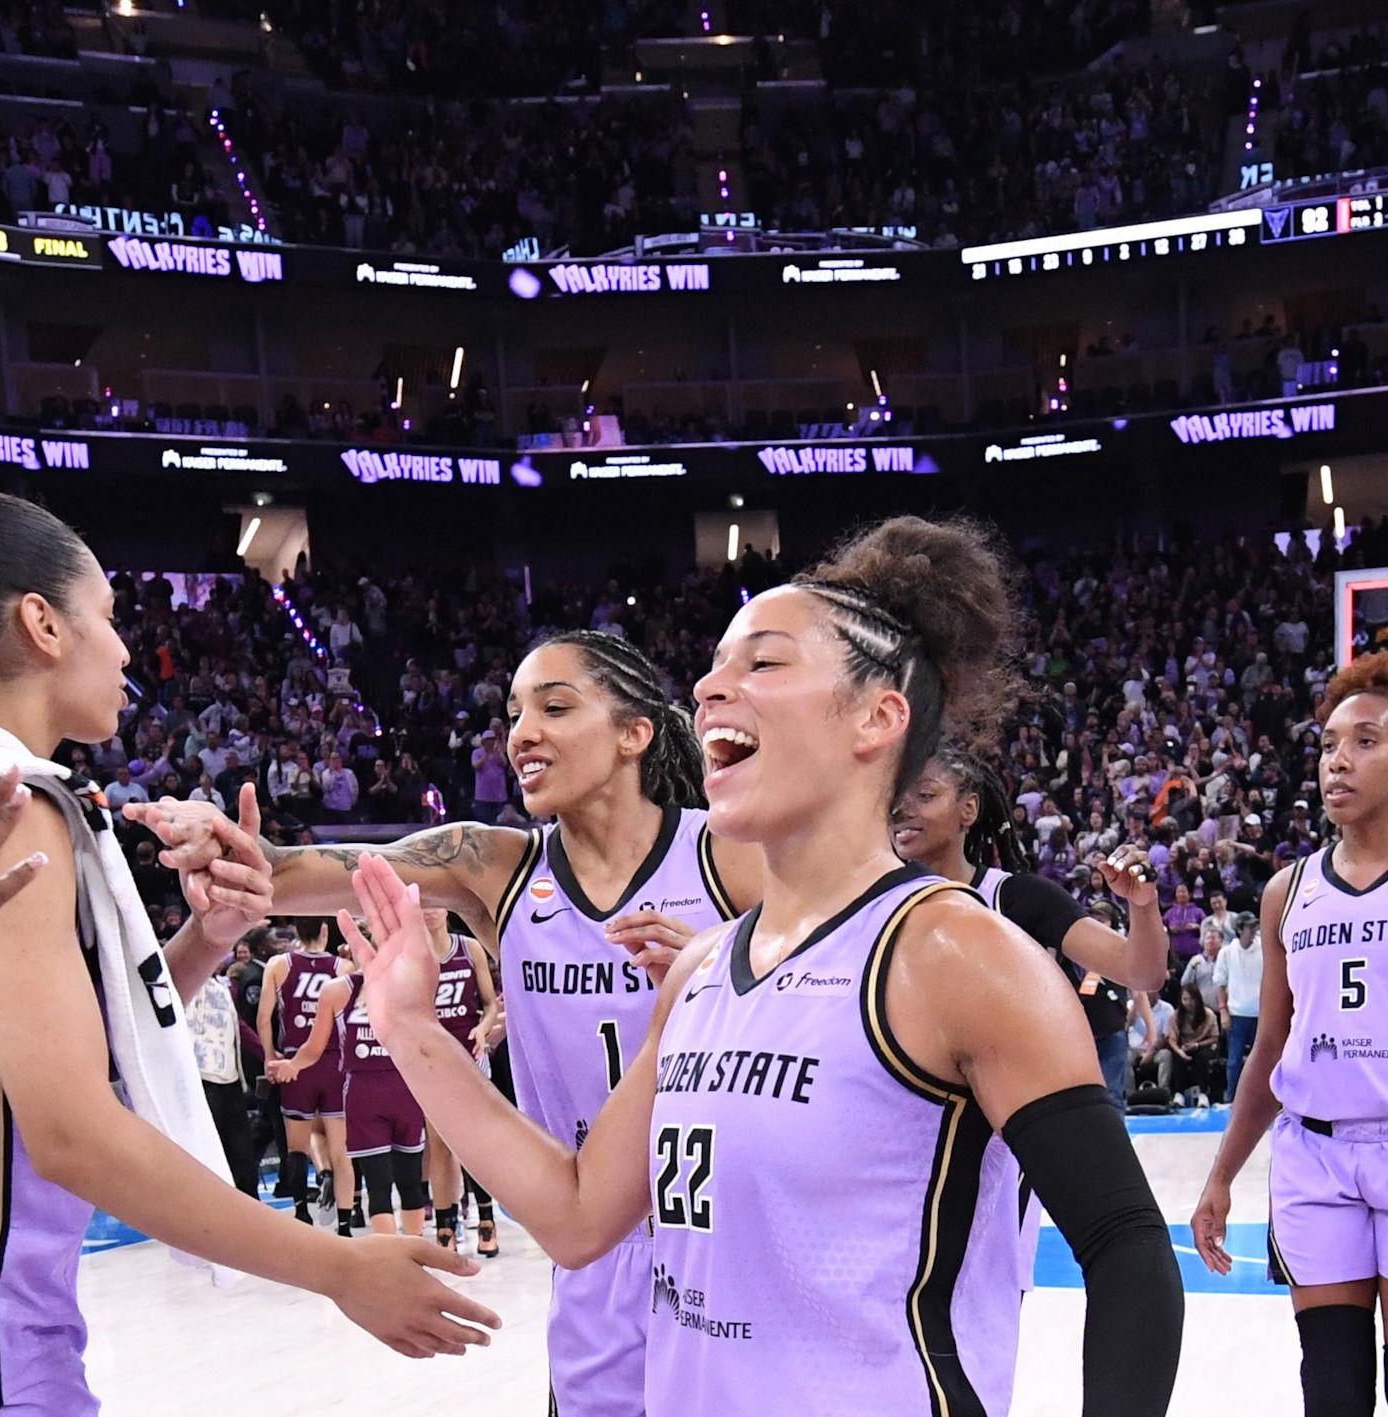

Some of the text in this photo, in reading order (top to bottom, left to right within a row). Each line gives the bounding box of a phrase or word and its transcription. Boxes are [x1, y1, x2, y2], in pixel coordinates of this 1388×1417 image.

[34, 238, 89, 258] FINAL
[108, 236, 282, 282] VALKYRIES WIN
[550, 264, 710, 293] VALKYRIES WIN
[1170, 404, 1335, 444] VALKYRIES WIN
[41, 440, 89, 469] WIN
[341, 449, 501, 484] VALKYRIES WIN
[758, 446, 913, 475] VALKYRIES WIN
[660, 897, 702, 912] freedom
[1291, 922, 1353, 954] GOLDEN
[293, 971, 332, 998] 10
[522, 961, 613, 994] GOLDEN
[796, 972, 852, 988] freedom
[1339, 958, 1368, 1012] 5
[435, 981, 465, 1006] 21
[596, 1019, 625, 1093] 1
[1342, 1038, 1373, 1047] KAISER
[708, 1051, 820, 1104] STATE
[655, 1124, 716, 1233] 22
